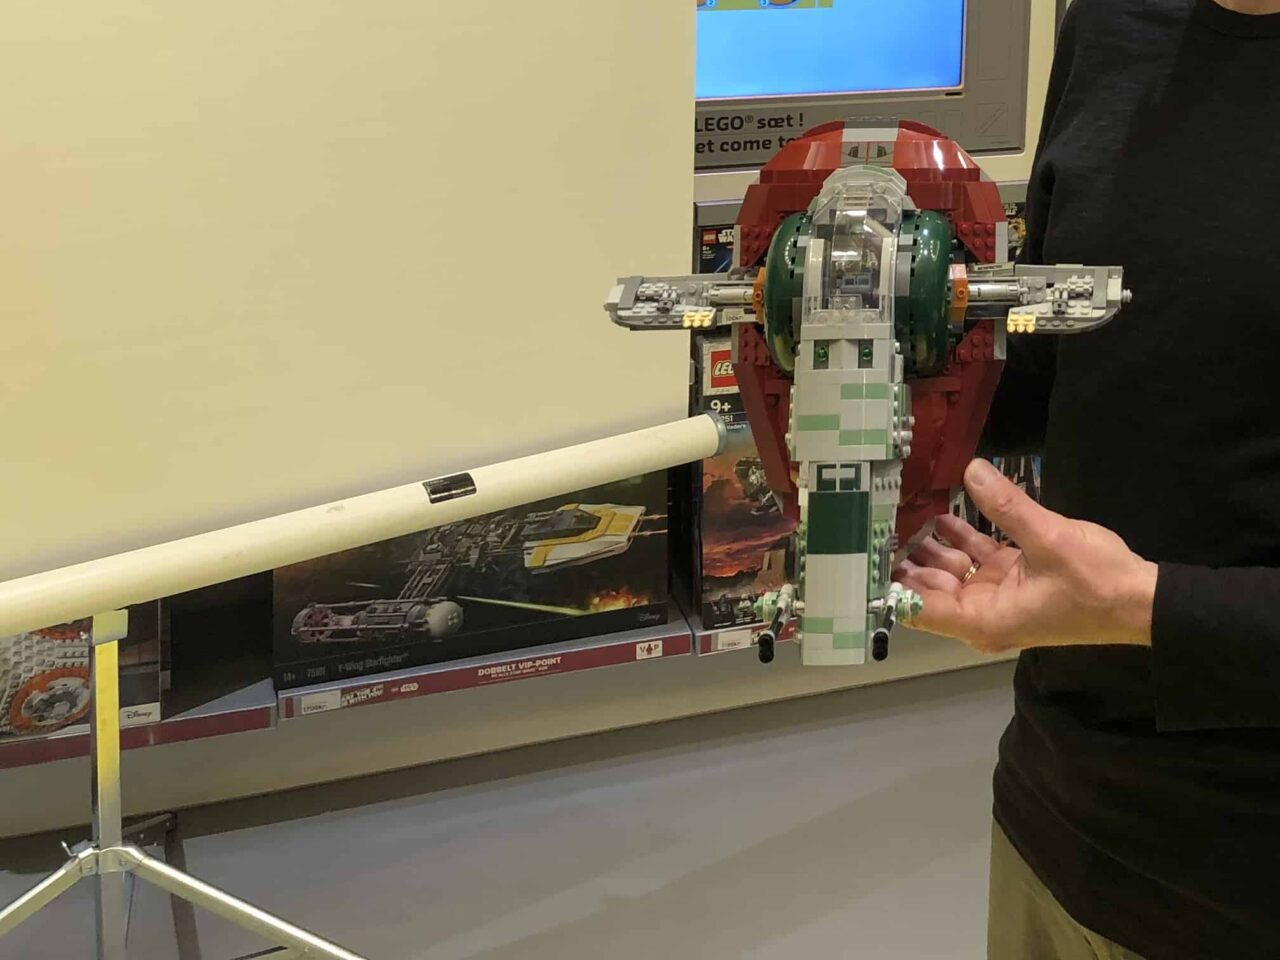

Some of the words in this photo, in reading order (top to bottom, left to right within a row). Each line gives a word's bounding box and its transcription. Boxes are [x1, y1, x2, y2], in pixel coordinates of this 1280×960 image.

[757, 115, 794, 129] sæt
[799, 113, 804, 127] !
[695, 141, 715, 154] et
[720, 139, 772, 153] come
[710, 400, 731, 414] 9+
[478, 663, 516, 676] DOBBELT
[518, 656, 562, 669] VIP-POINT
[125, 709, 152, 720] Disney
